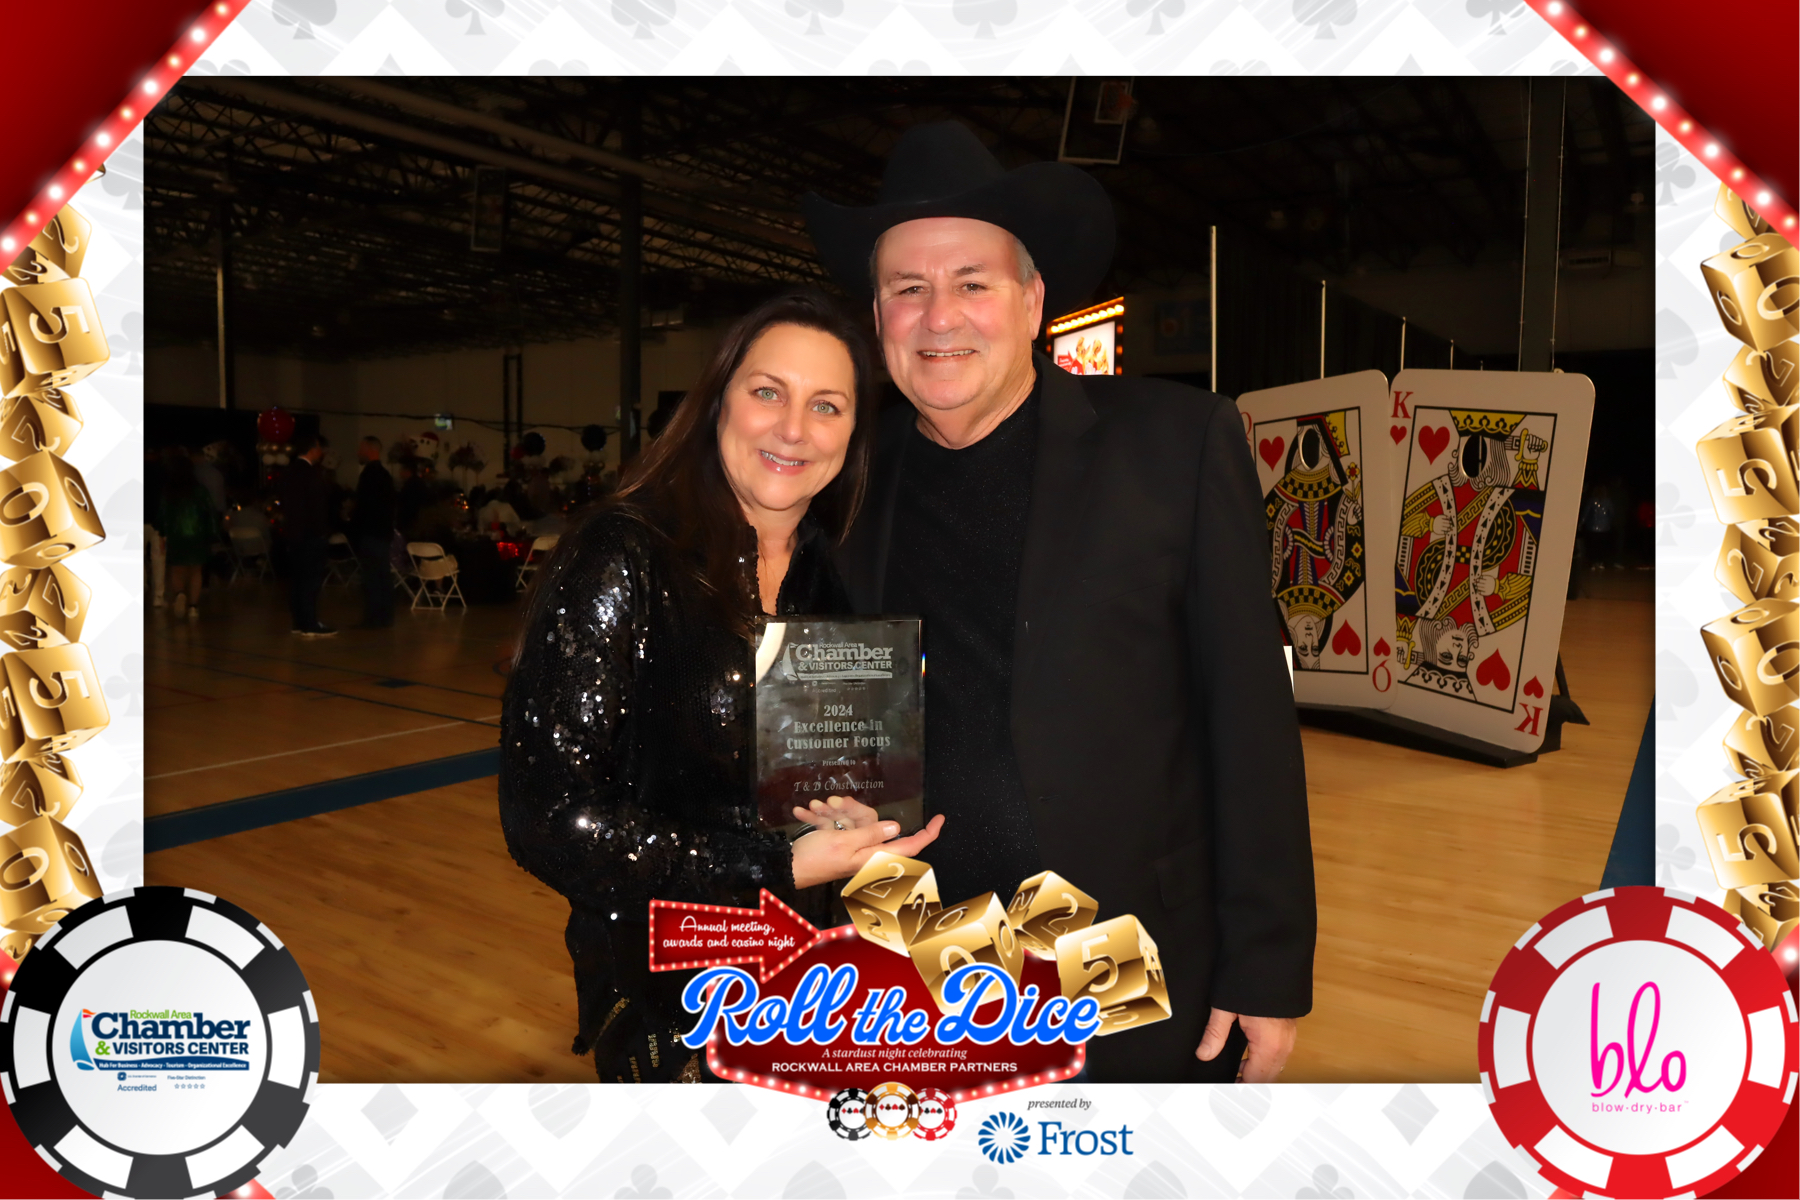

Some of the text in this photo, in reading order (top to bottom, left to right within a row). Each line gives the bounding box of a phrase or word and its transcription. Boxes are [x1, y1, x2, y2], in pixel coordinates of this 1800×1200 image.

[1390, 391, 1414, 419] K
[795, 643, 893, 661] Chamber
[798, 661, 892, 671] & VISITORS CENTER
[1372, 659, 1391, 692] Q
[824, 704, 853, 717] 2024
[794, 719, 883, 734] Excellence in
[1514, 702, 1544, 736] K
[787, 736, 891, 750] Customer Focus
[794, 780, 884, 792] T & D Construction
